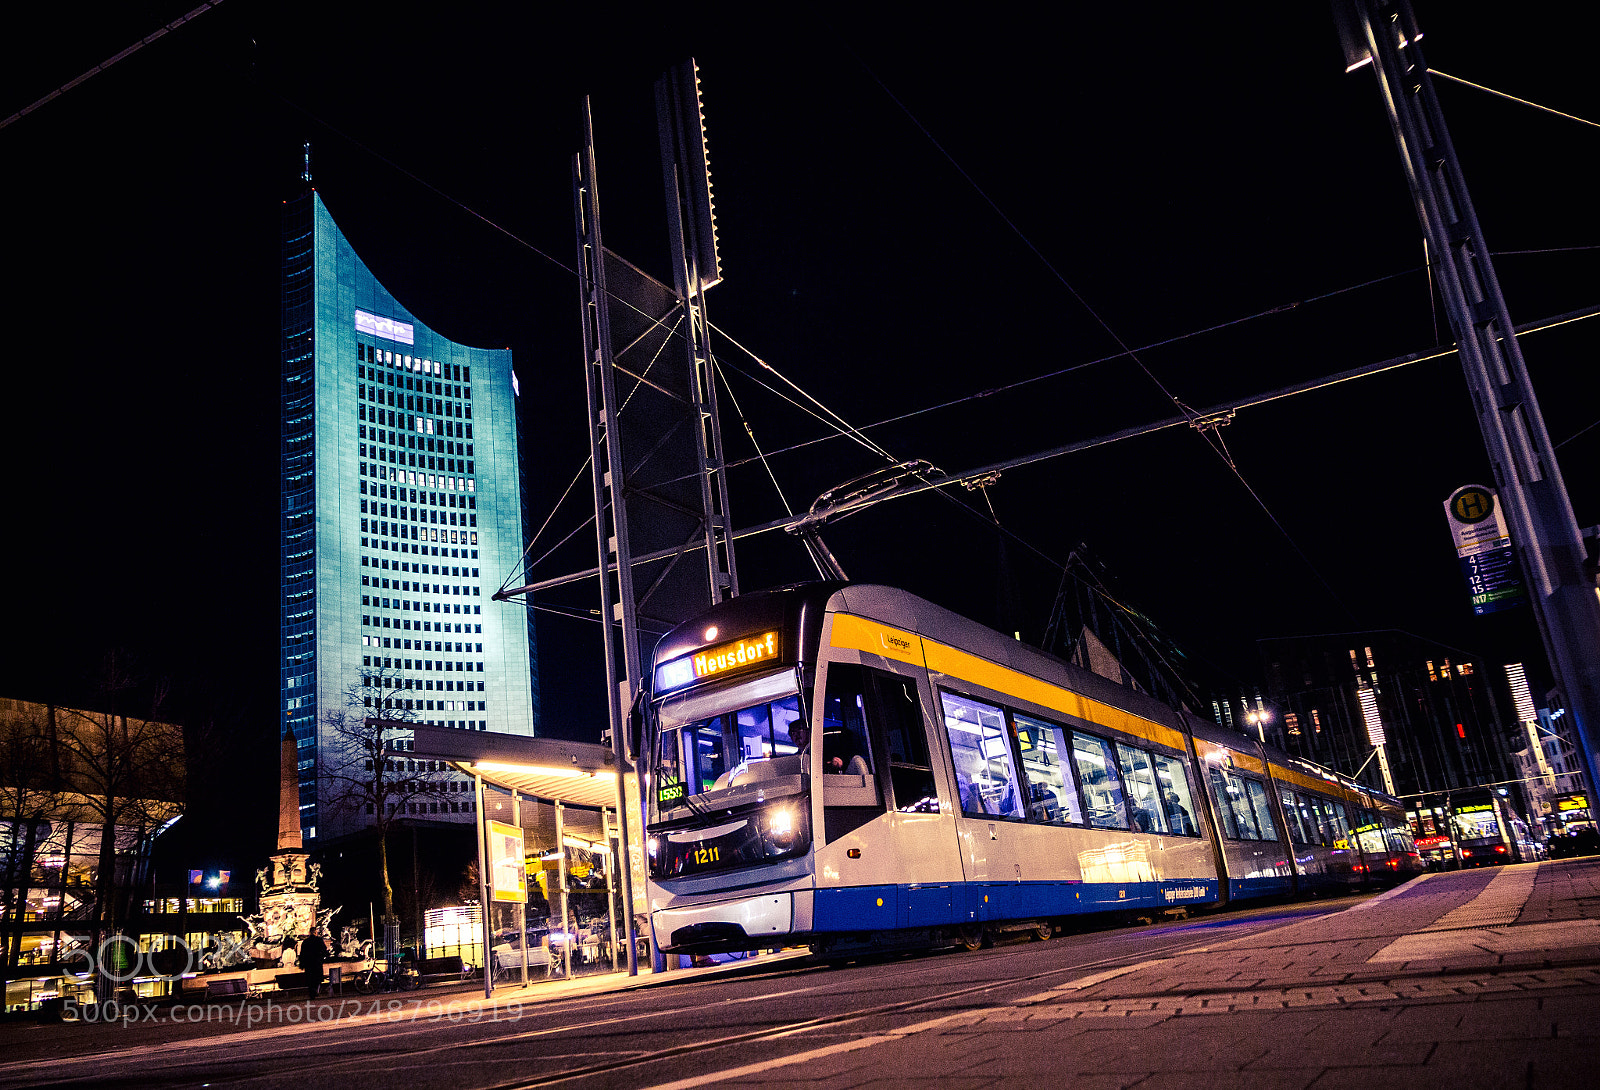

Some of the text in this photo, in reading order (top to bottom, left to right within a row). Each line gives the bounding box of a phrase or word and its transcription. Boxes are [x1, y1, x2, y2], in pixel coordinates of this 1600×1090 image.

[1461, 494, 1484, 517] H
[1469, 556, 1476, 564] 4
[1471, 565, 1478, 574] 7
[1469, 575, 1481, 585] 12
[1472, 584, 1484, 594] 15
[695, 634, 774, 676] Meusdorf
[694, 847, 720, 865] 1211
